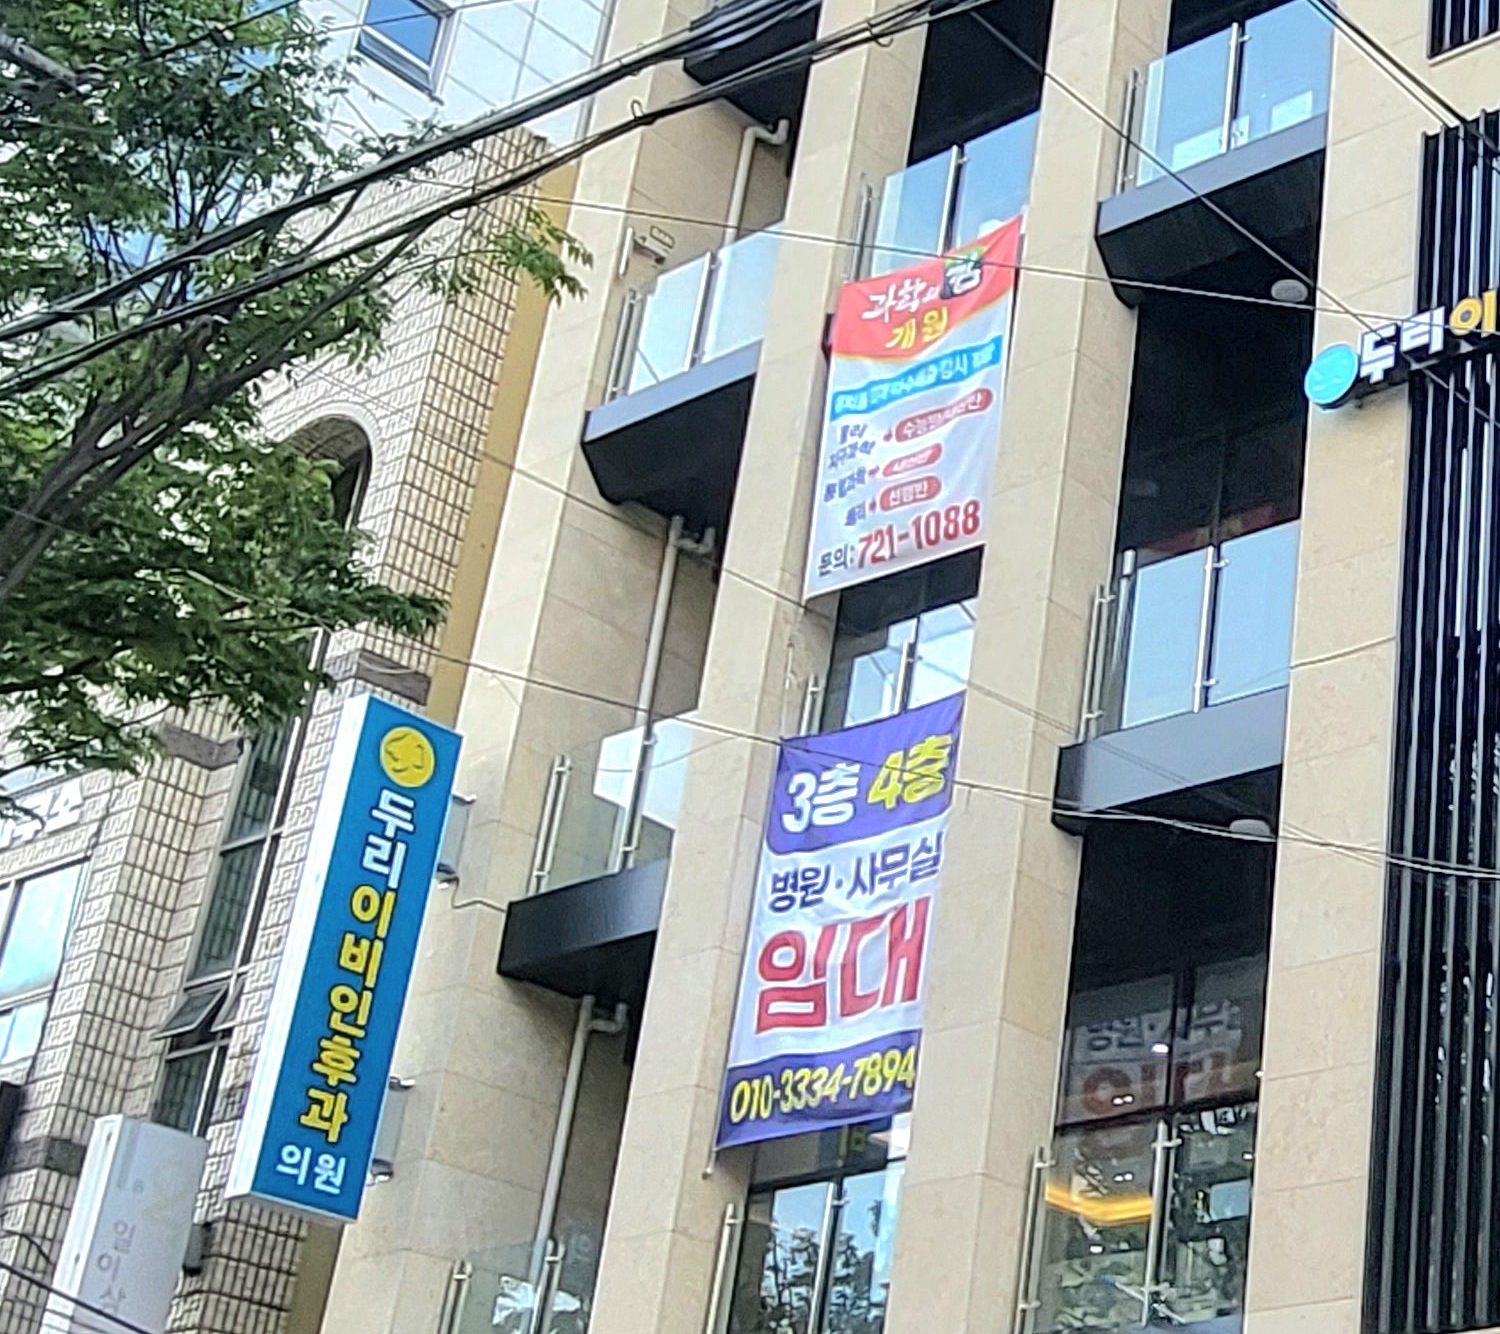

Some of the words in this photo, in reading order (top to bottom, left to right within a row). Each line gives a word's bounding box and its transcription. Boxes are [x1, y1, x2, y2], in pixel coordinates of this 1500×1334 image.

[858, 499, 981, 568] 721-1088
[782, 762, 861, 834] 3층
[867, 733, 951, 810] 4층
[756, 896, 930, 1034] 임대
[730, 1046, 915, 1123] 010-3334-7894
[275, 1143, 347, 1197] 의원
